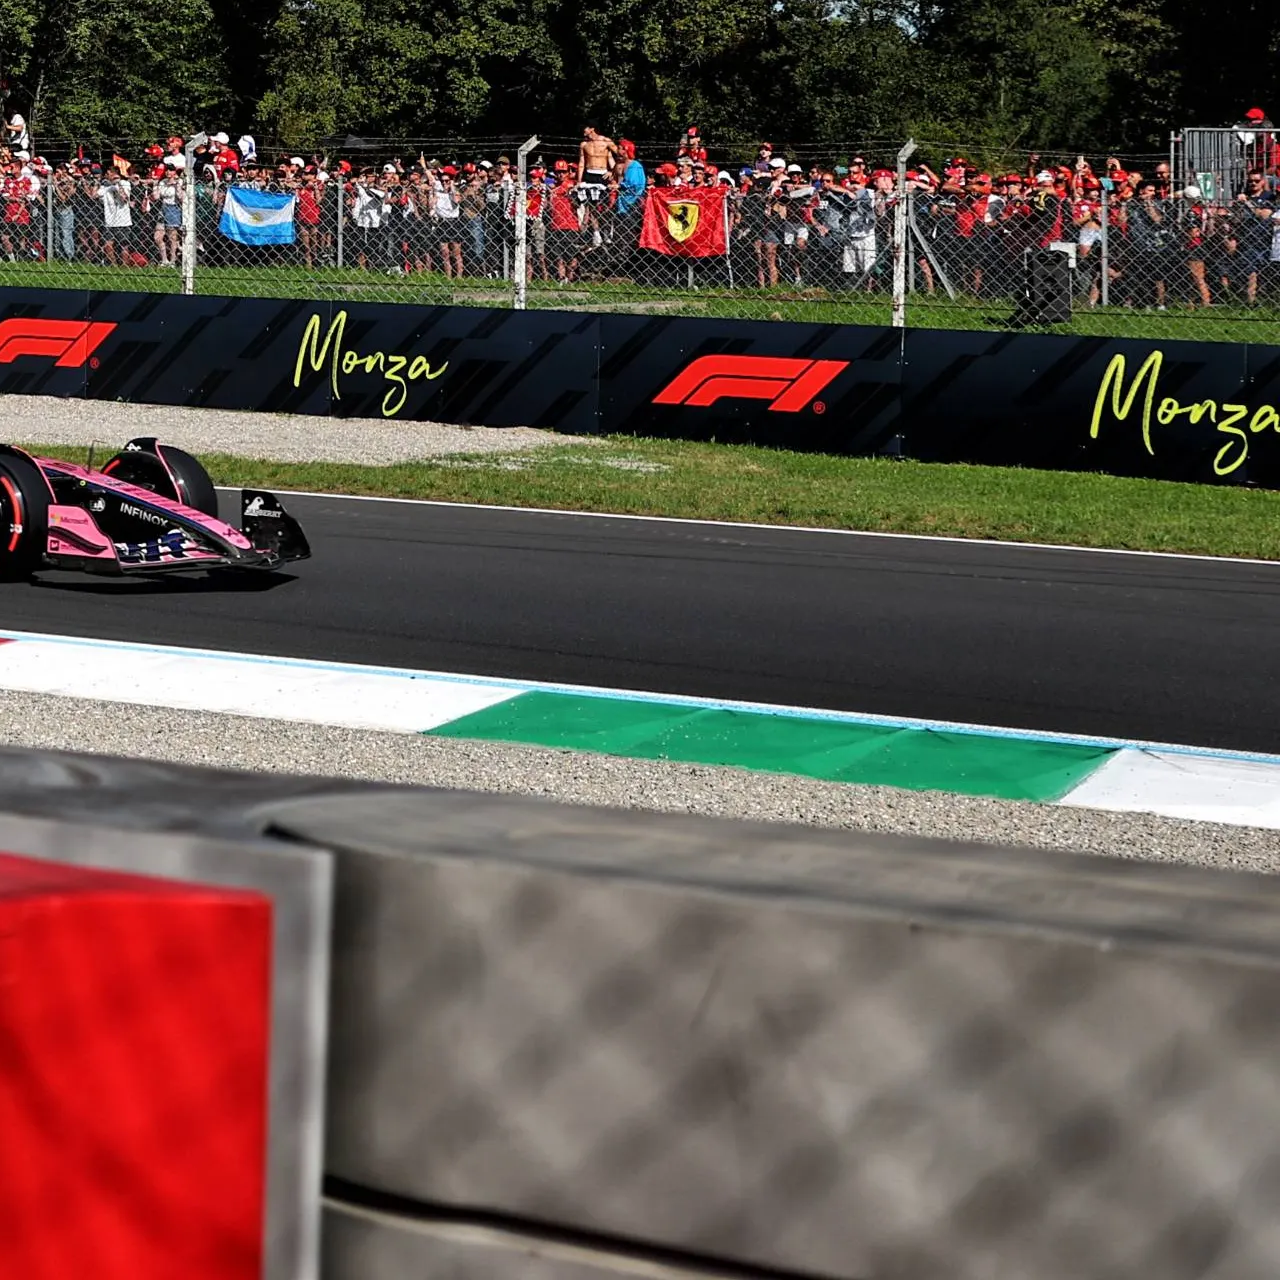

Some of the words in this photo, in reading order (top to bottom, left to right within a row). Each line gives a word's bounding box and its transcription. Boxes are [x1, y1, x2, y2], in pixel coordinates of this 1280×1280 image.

[294, 310, 448, 416] Monza
[1089, 350, 1280, 475] Monza
[120, 502, 169, 528] INFINOX
